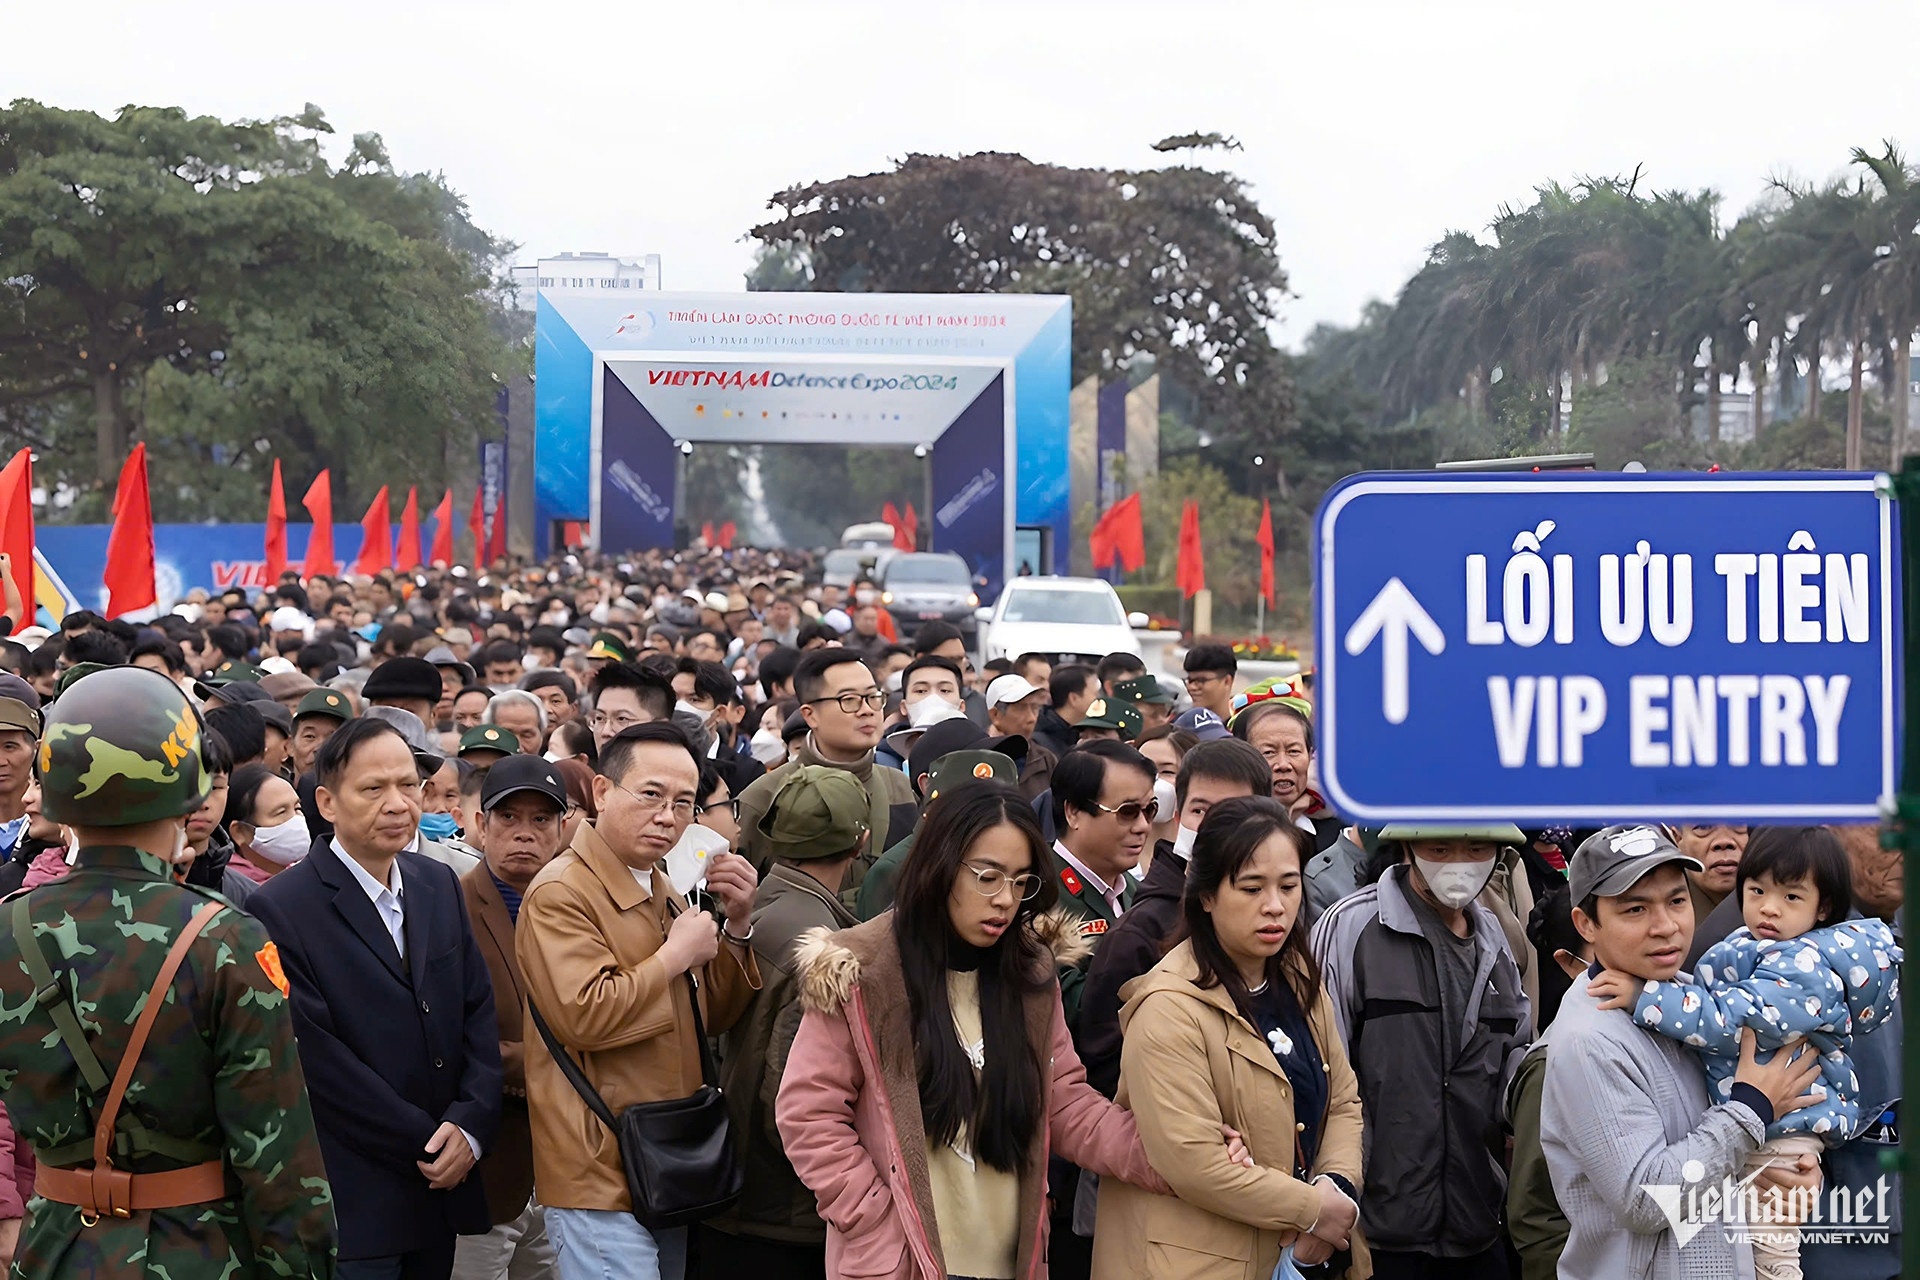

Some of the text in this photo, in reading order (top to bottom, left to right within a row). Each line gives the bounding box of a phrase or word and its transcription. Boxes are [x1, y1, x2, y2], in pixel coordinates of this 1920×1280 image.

[1465, 519, 1870, 647] LỐI ƯU TIÊN
[1486, 674, 1851, 768] VIP ENTRY
